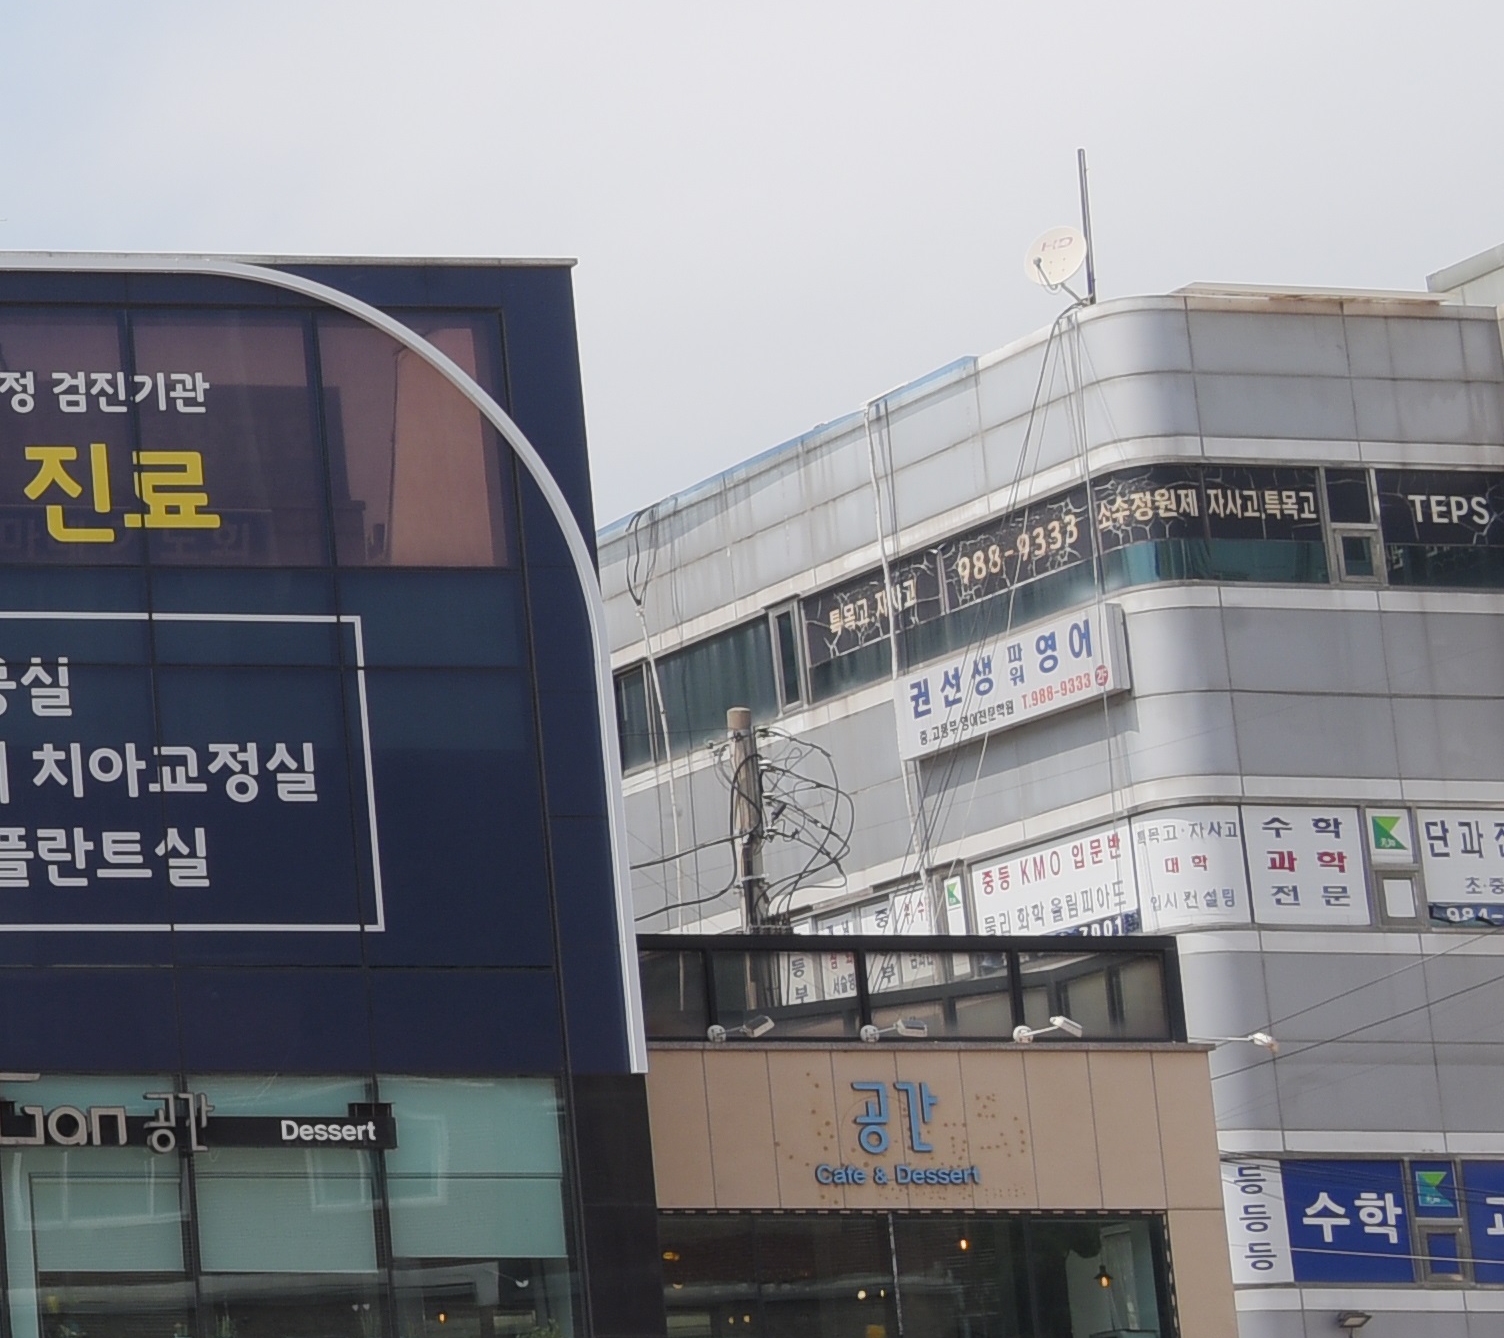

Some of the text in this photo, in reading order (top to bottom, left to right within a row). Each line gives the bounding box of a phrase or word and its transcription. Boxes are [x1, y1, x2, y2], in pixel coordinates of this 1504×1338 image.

[52, 371, 210, 415] 검진기관
[24, 444, 222, 544] 진료
[1407, 493, 1490, 525] TEPS
[957, 513, 1080, 585] 988-9333
[909, 654, 995, 720] 권선생
[1035, 618, 1094, 674] 영어
[31, 742, 319, 804] 치아교정실
[1262, 816, 1343, 839] 수학
[1019, 849, 1062, 887] KMO
[1266, 849, 1348, 873] 과학
[1271, 884, 1351, 908] 전문
[281, 1118, 377, 1142] Dessert
[850, 1080, 938, 1154] 공간
[815, 1163, 867, 1186] Cafe
[894, 1163, 981, 1186] Dessert
[1301, 1191, 1403, 1245] 수학
